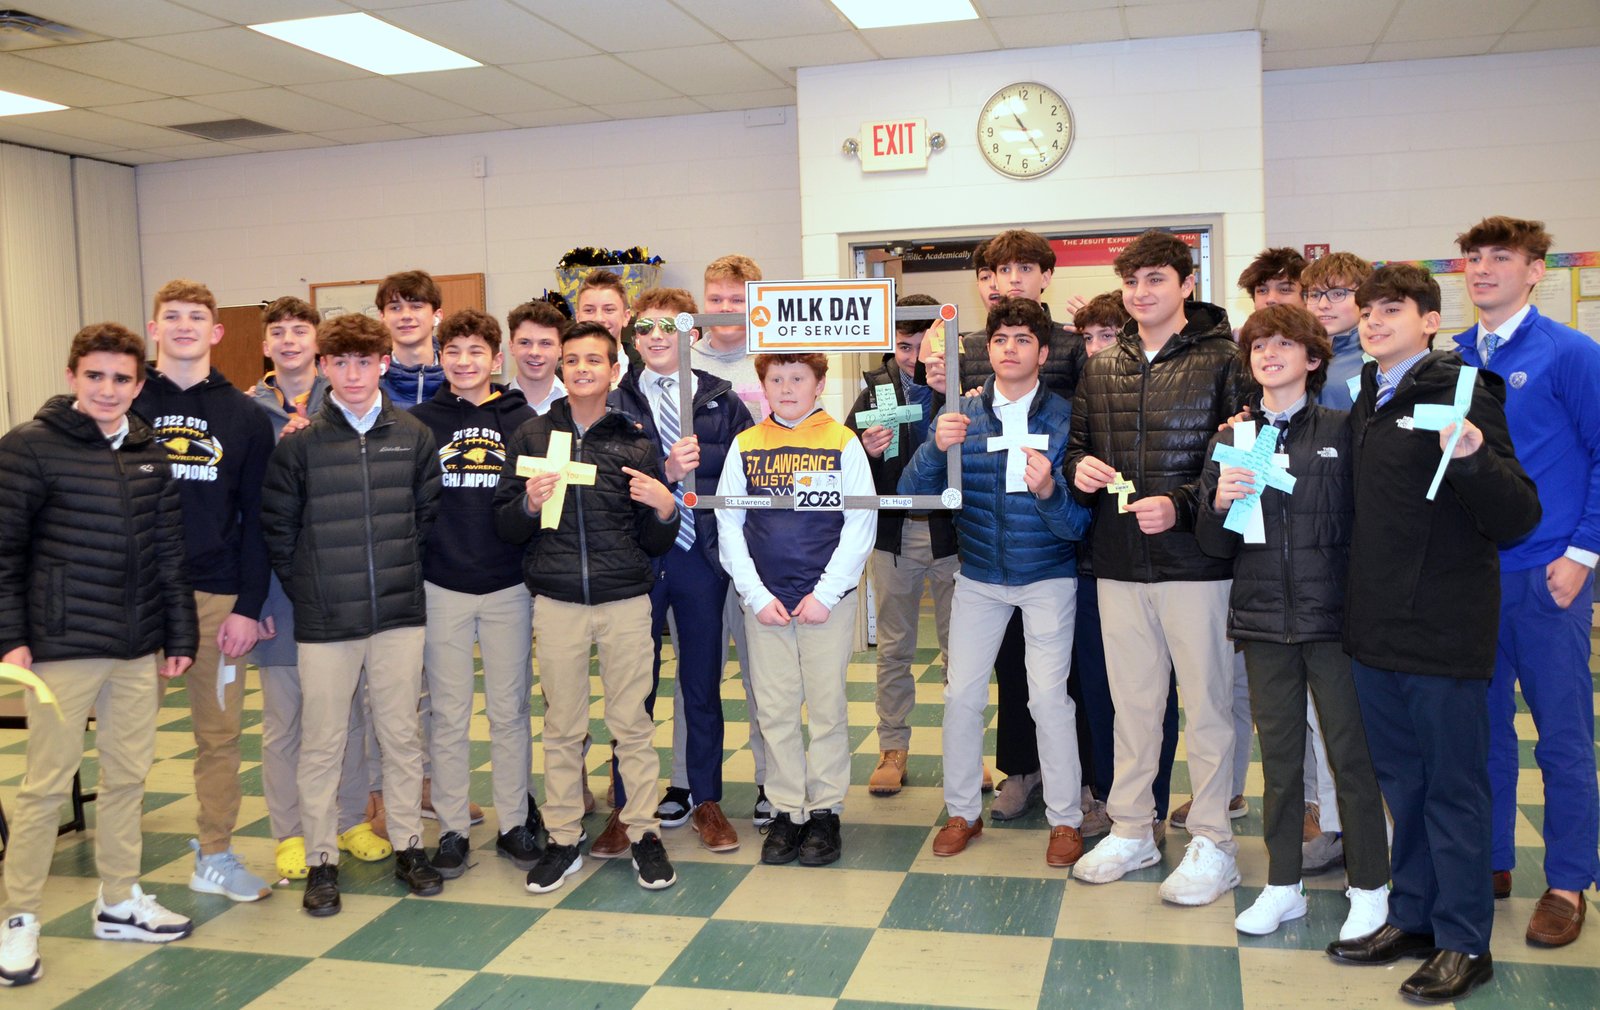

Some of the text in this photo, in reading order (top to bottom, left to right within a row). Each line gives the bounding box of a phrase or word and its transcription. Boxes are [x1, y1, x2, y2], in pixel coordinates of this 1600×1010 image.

[1051, 105, 1057, 116] 2
[987, 127, 994, 137] 9
[1056, 122, 1063, 132] 3
[873, 123, 916, 157] EXIT
[1052, 139, 1059, 150] 4
[992, 143, 999, 153] 8
[1005, 154, 1012, 165] 7
[1022, 158, 1028, 169] 6
[925, 250, 972, 260] Academically
[778, 297, 872, 322] MLK DAY
[778, 325, 870, 336] OF SERVICE
[167, 453, 210, 462] AWRENCE
[765, 453, 835, 473] LAWRENCE
[172, 463, 218, 481] PIONS
[442, 473, 500, 488] CHMPIO
[751, 474, 794, 487] MUSTA
[737, 498, 770, 506] Lawrence
[797, 491, 841, 507] 2023
[892, 498, 912, 506] Hugo
